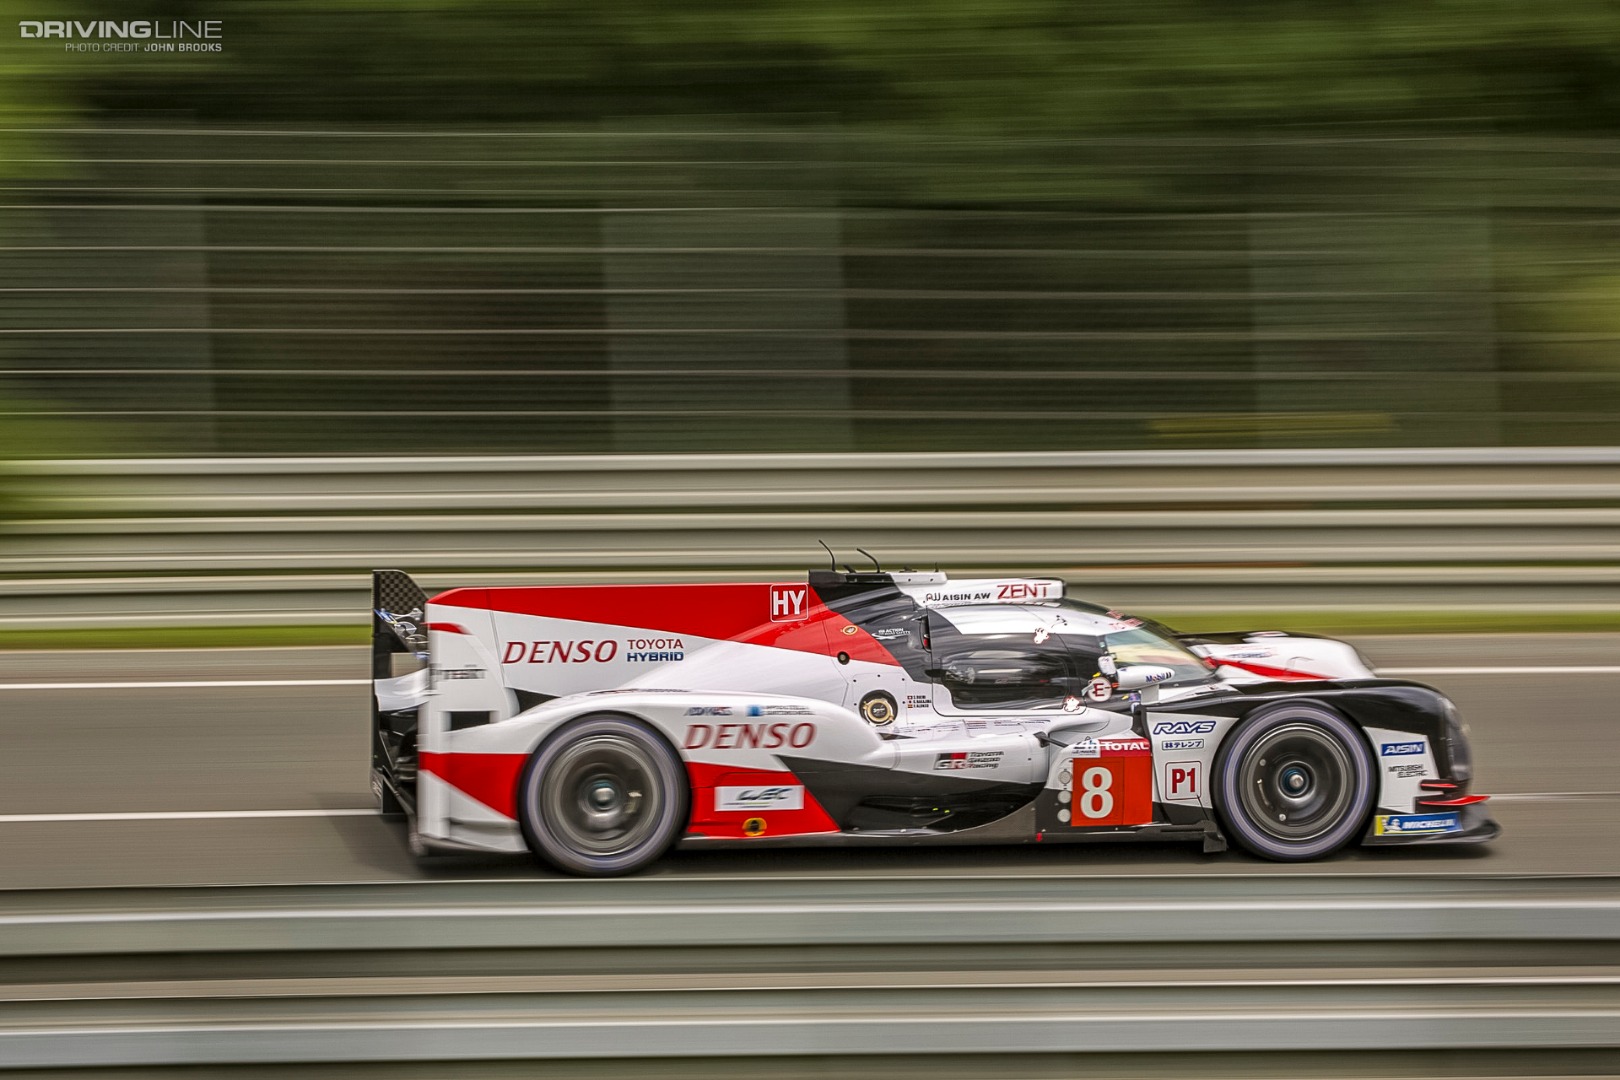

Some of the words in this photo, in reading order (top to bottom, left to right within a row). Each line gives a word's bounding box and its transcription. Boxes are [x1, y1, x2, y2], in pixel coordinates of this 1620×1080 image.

[943, 593, 971, 601] AISIN
[974, 592, 991, 600] AW
[997, 583, 1051, 600] ZENT
[773, 590, 806, 616] HY
[627, 639, 684, 649] TOYOTA
[501, 640, 618, 664] DENSO
[627, 652, 684, 662] HYBRID
[1093, 683, 1105, 696] E
[1153, 721, 1216, 735] RAYS
[681, 723, 816, 749] DENSO
[1101, 741, 1150, 751] TOTAL
[1384, 744, 1423, 754] AISIN
[1172, 768, 1195, 793] P1
[1080, 766, 1114, 819] 8
